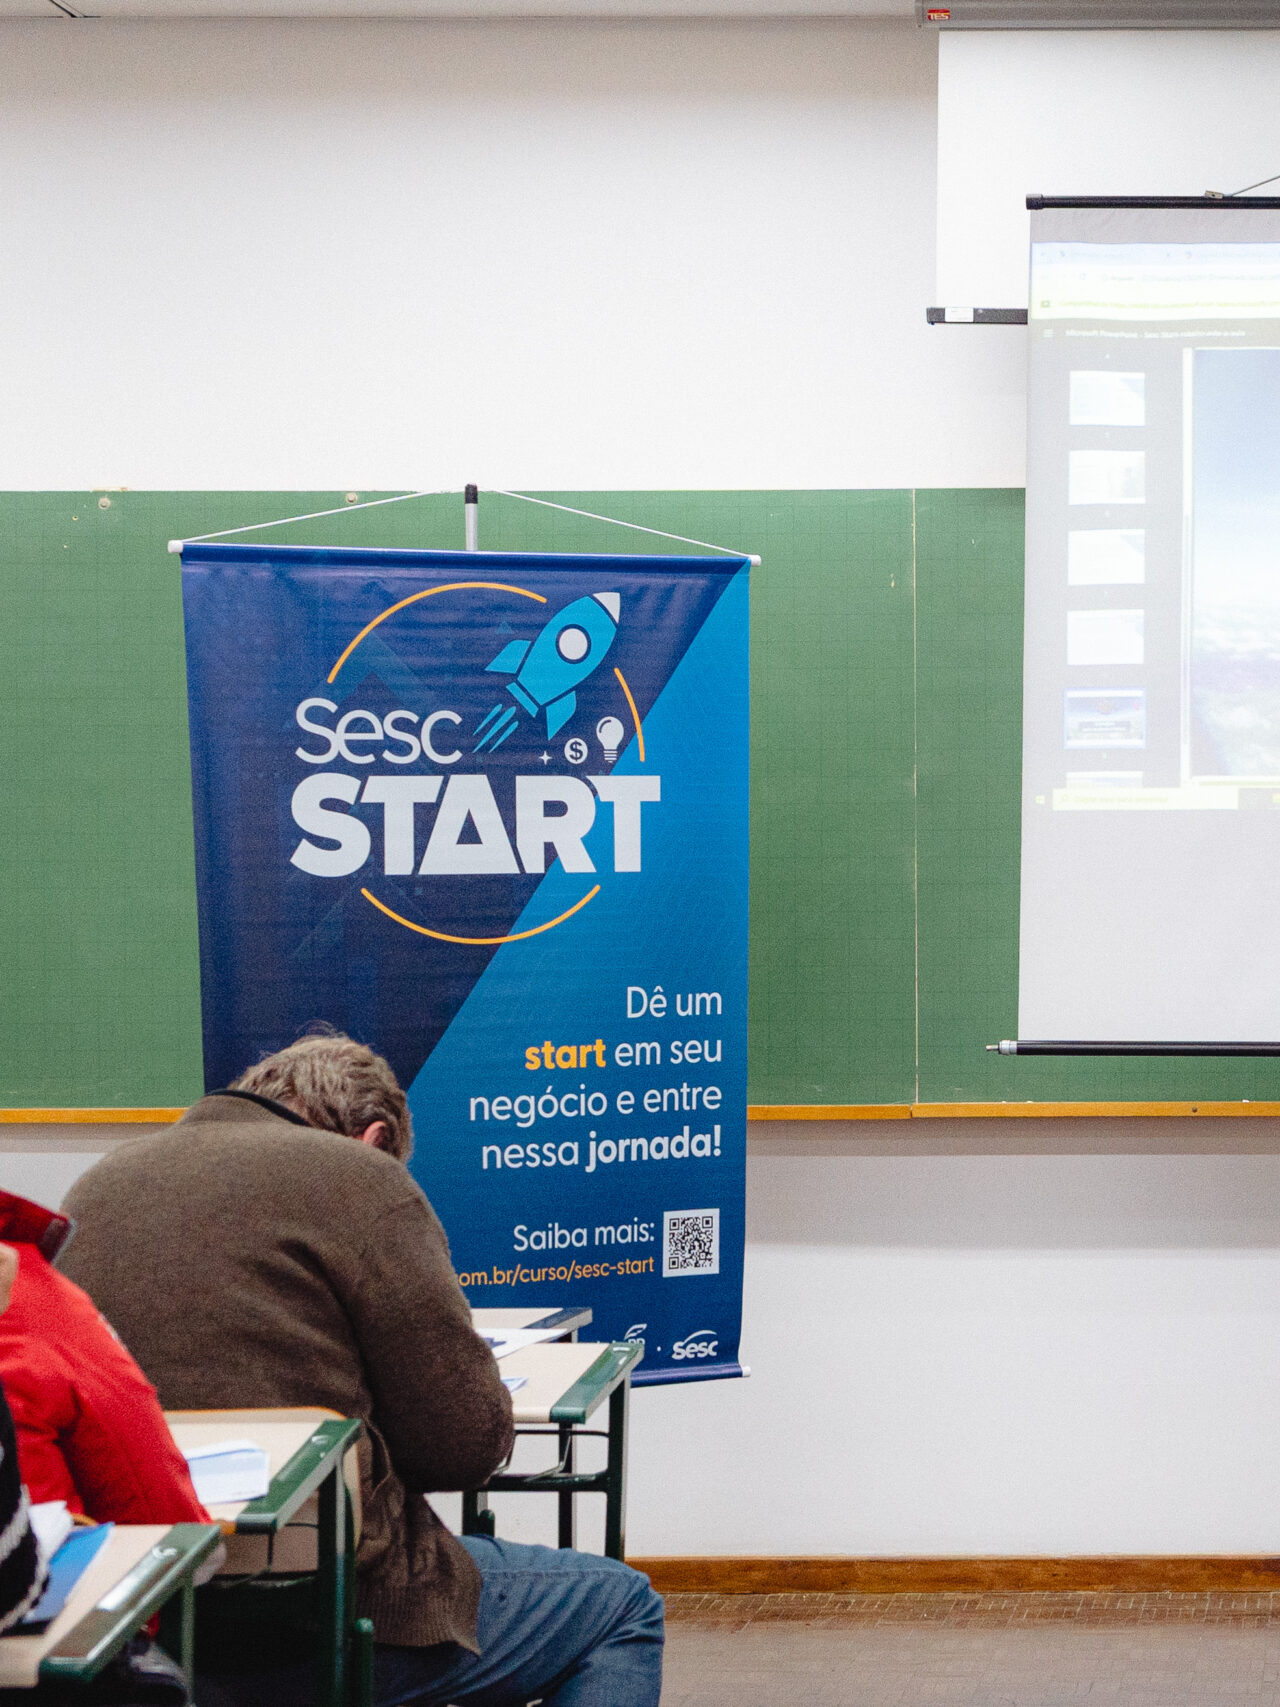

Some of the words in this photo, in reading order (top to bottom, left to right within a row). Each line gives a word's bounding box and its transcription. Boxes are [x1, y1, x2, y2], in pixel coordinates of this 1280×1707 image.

[296, 698, 462, 764] Sesc
[290, 773, 660, 877] START
[628, 985, 667, 1018] Dê
[676, 992, 722, 1017] um
[525, 1039, 606, 1070] start
[614, 1043, 661, 1067] em
[670, 1040, 722, 1064] seu
[470, 1084, 607, 1128] negócio
[616, 1091, 634, 1115] e
[644, 1083, 722, 1113] entre
[482, 1141, 579, 1170] nessa
[585, 1125, 721, 1173] jornada!
[513, 1223, 587, 1251] Saiba
[594, 1216, 655, 1245] mais:
[458, 1257, 655, 1288] om.br/curso/sesc-start
